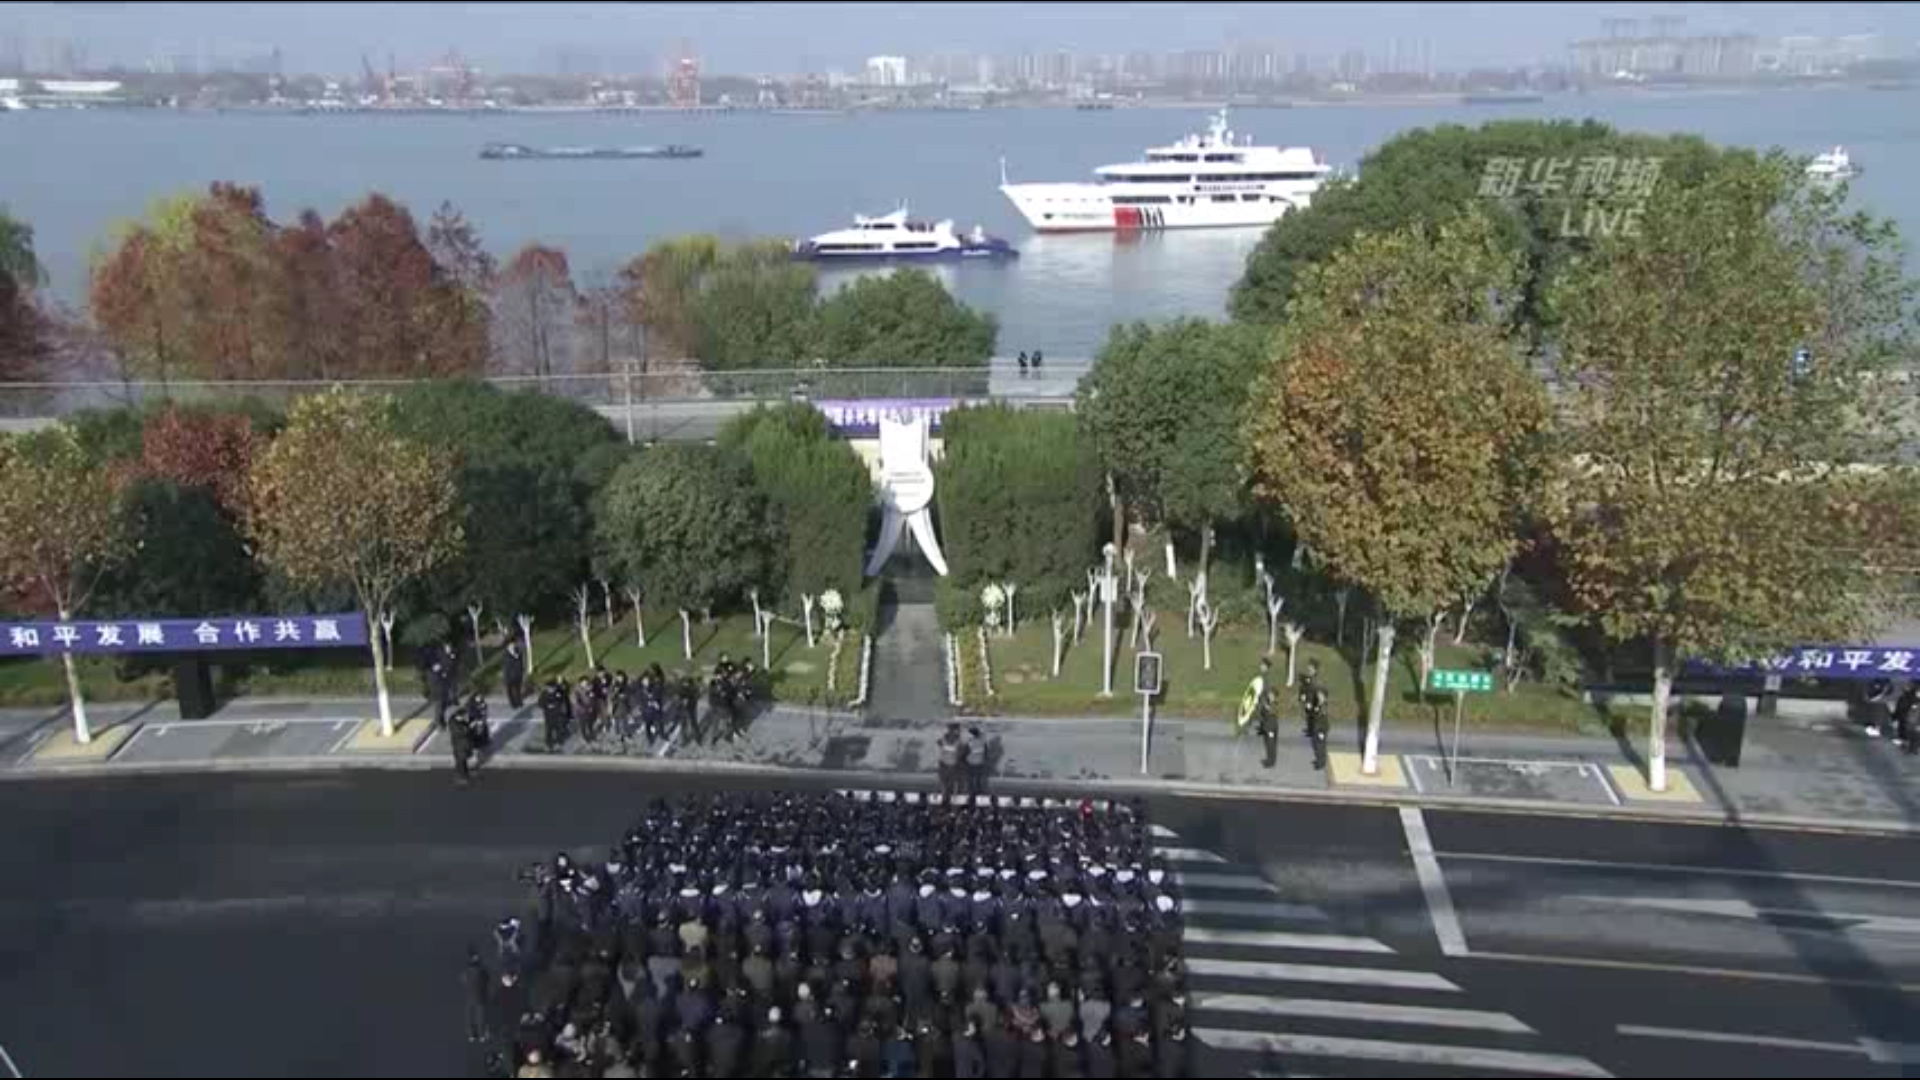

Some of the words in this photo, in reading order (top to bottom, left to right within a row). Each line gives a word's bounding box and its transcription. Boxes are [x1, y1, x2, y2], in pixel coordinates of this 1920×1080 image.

[10, 622, 165, 648] 和平发展
[193, 619, 341, 644] 合作共赢
